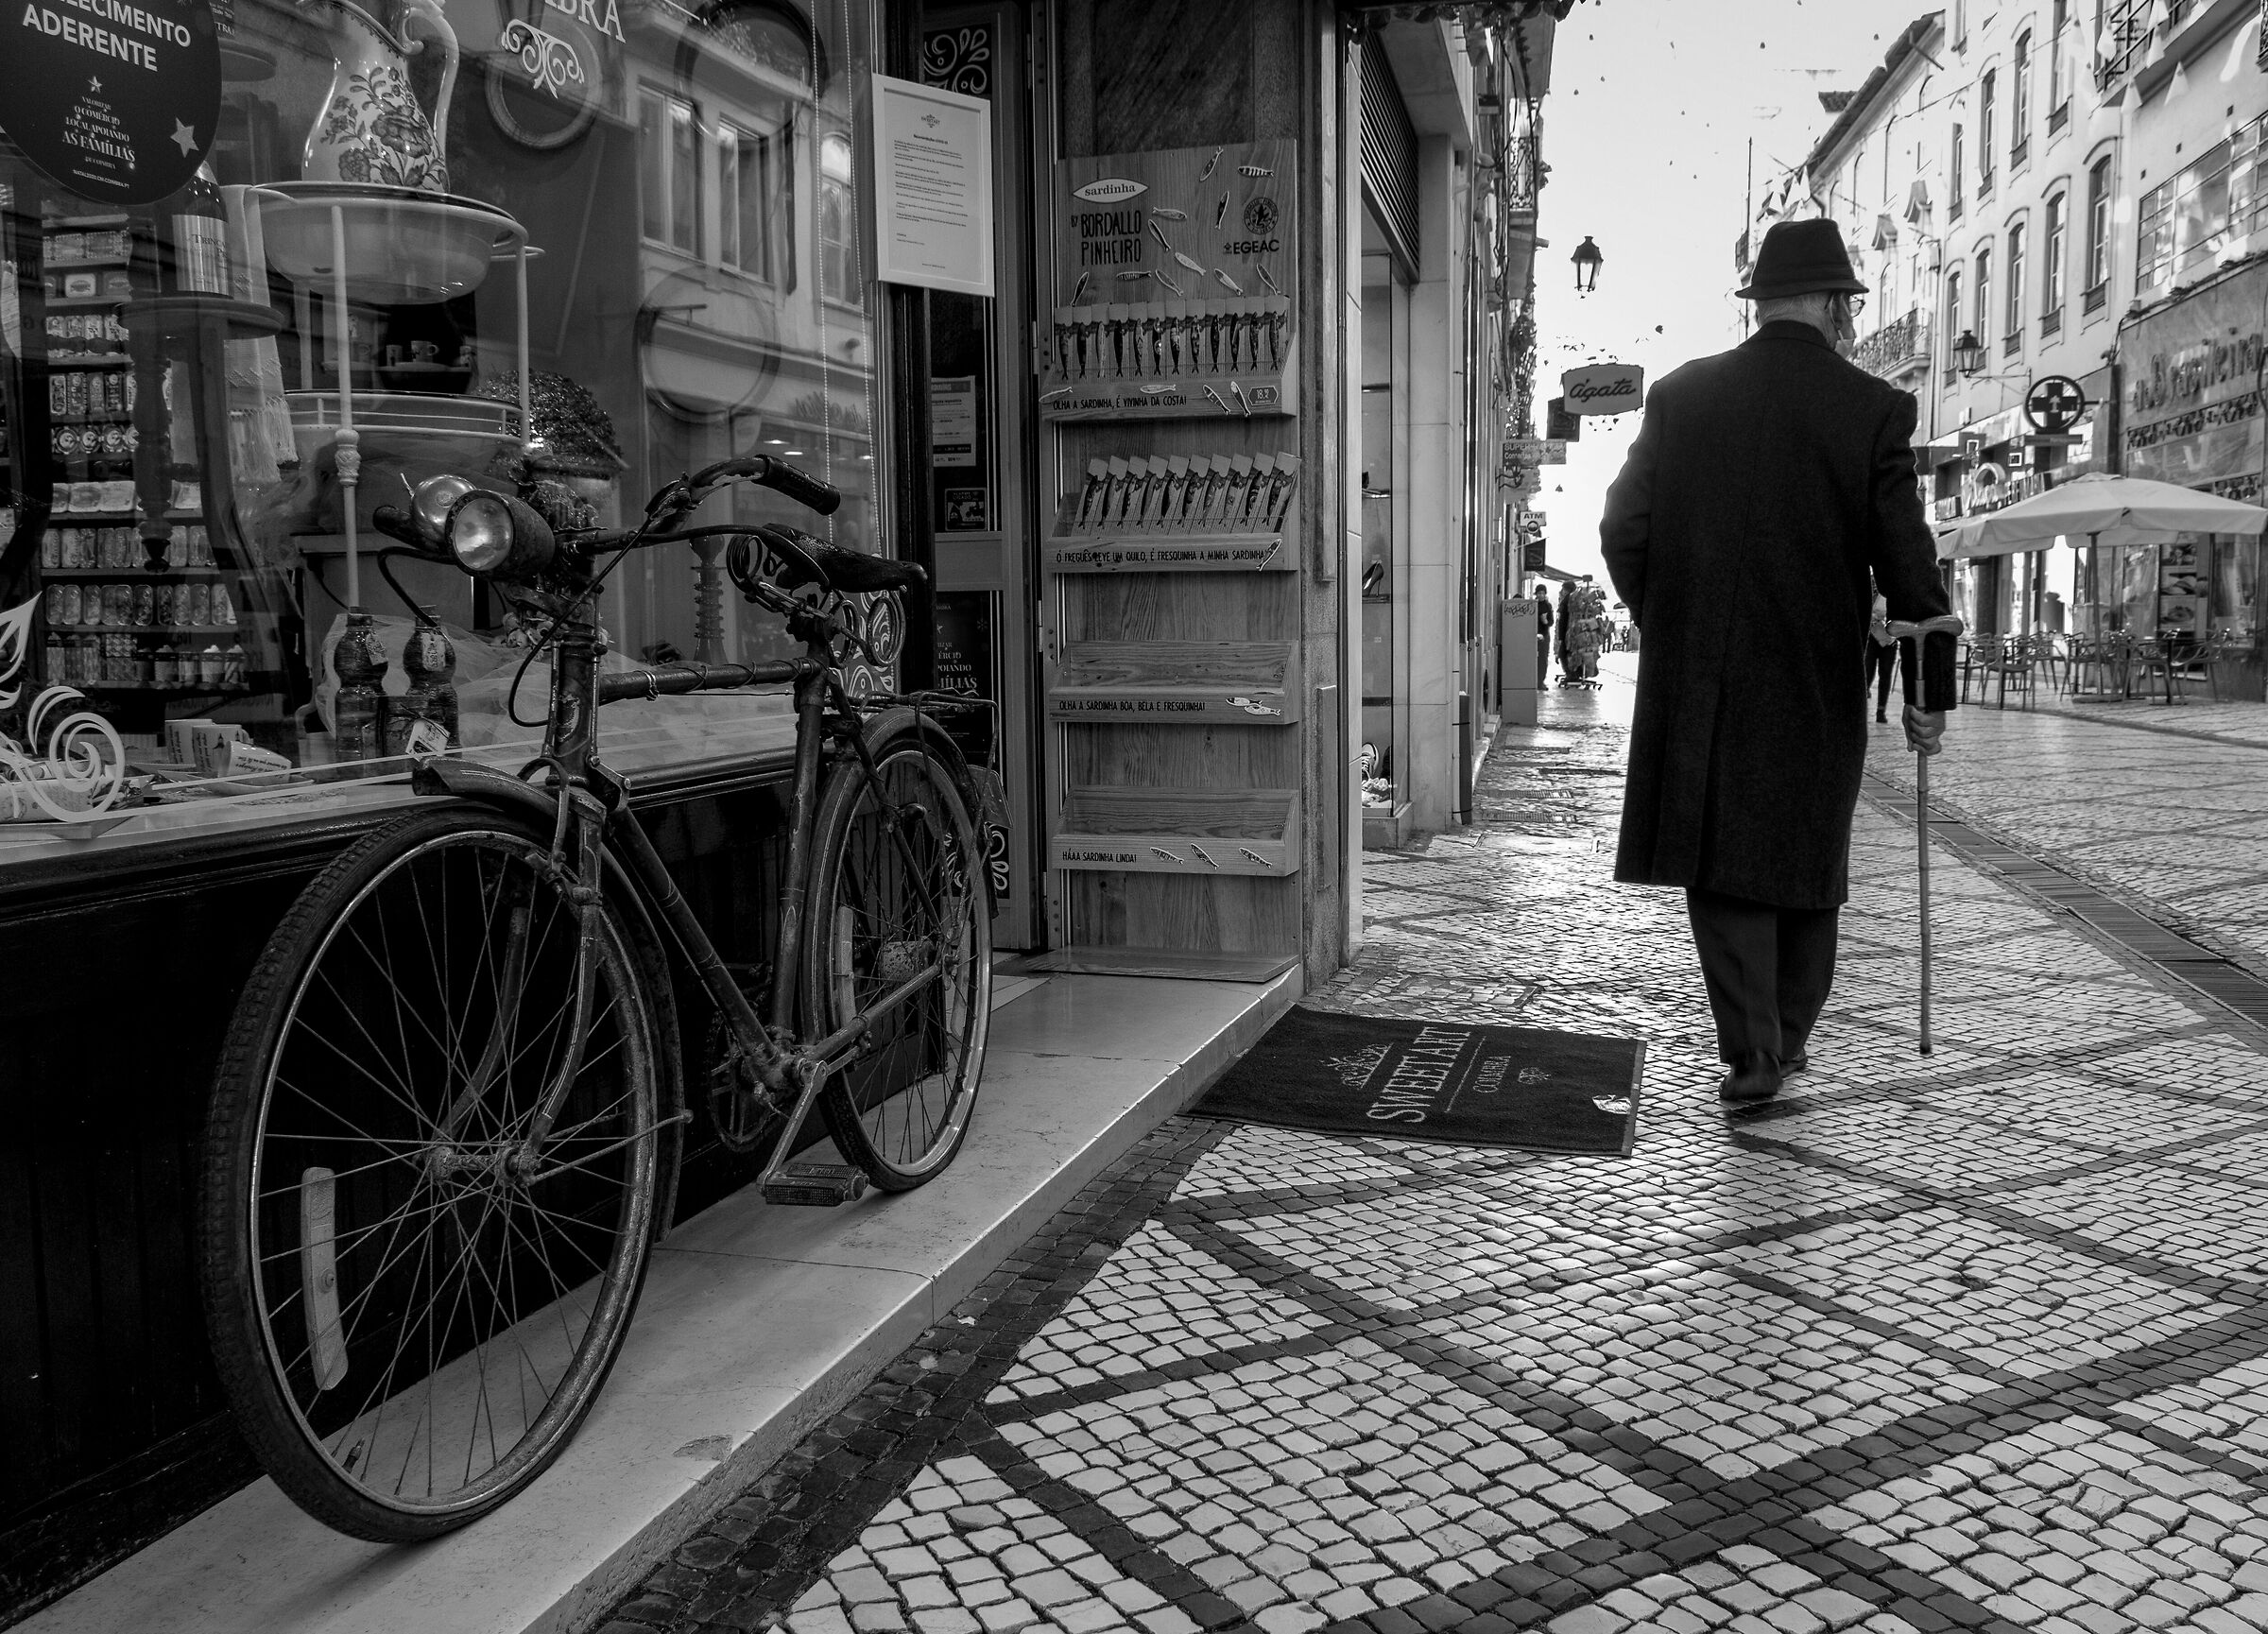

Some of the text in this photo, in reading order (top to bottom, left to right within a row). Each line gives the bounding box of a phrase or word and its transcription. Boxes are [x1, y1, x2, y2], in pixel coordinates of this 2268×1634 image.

[60, 0, 191, 47] CIMENTO
[545, 0, 627, 43] RA
[23, 3, 158, 72] ADERENTE
[66, 116, 130, 143] LOCAL APOIANDO
[62, 130, 136, 163] AS FAMÍLIAS
[1084, 183, 1137, 197] sardinha
[1071, 210, 1142, 238] BY BORDALLO
[1080, 238, 1142, 267] PINHEIRO
[1233, 239, 1280, 255] EGEAC
[1053, 400, 1071, 410] OLHA
[1073, 400, 1078, 409] A
[1080, 398, 1115, 410] SARDINHA,
[1116, 394, 1121, 407] É
[1150, 396, 1160, 406] DA
[1162, 395, 1187, 406] COSTA!
[1064, 549, 1092, 562] FREGUÊS
[1112, 552, 1123, 563] UM
[1125, 552, 1147, 564] QUILO,
[1150, 547, 1155, 561] É
[1158, 551, 1197, 561] FRESQUINHA
[1199, 551, 1205, 560] A
[1208, 550, 1228, 560] MINHA
[1058, 699, 1205, 713] OLHA A SARDINHA BOA, BELA E FRESQUINHA!
[1082, 851, 1113, 862] SARDINHA
[1115, 853, 1137, 863] LINDA!
[1472, 1056, 1512, 1093] COIMBRA
